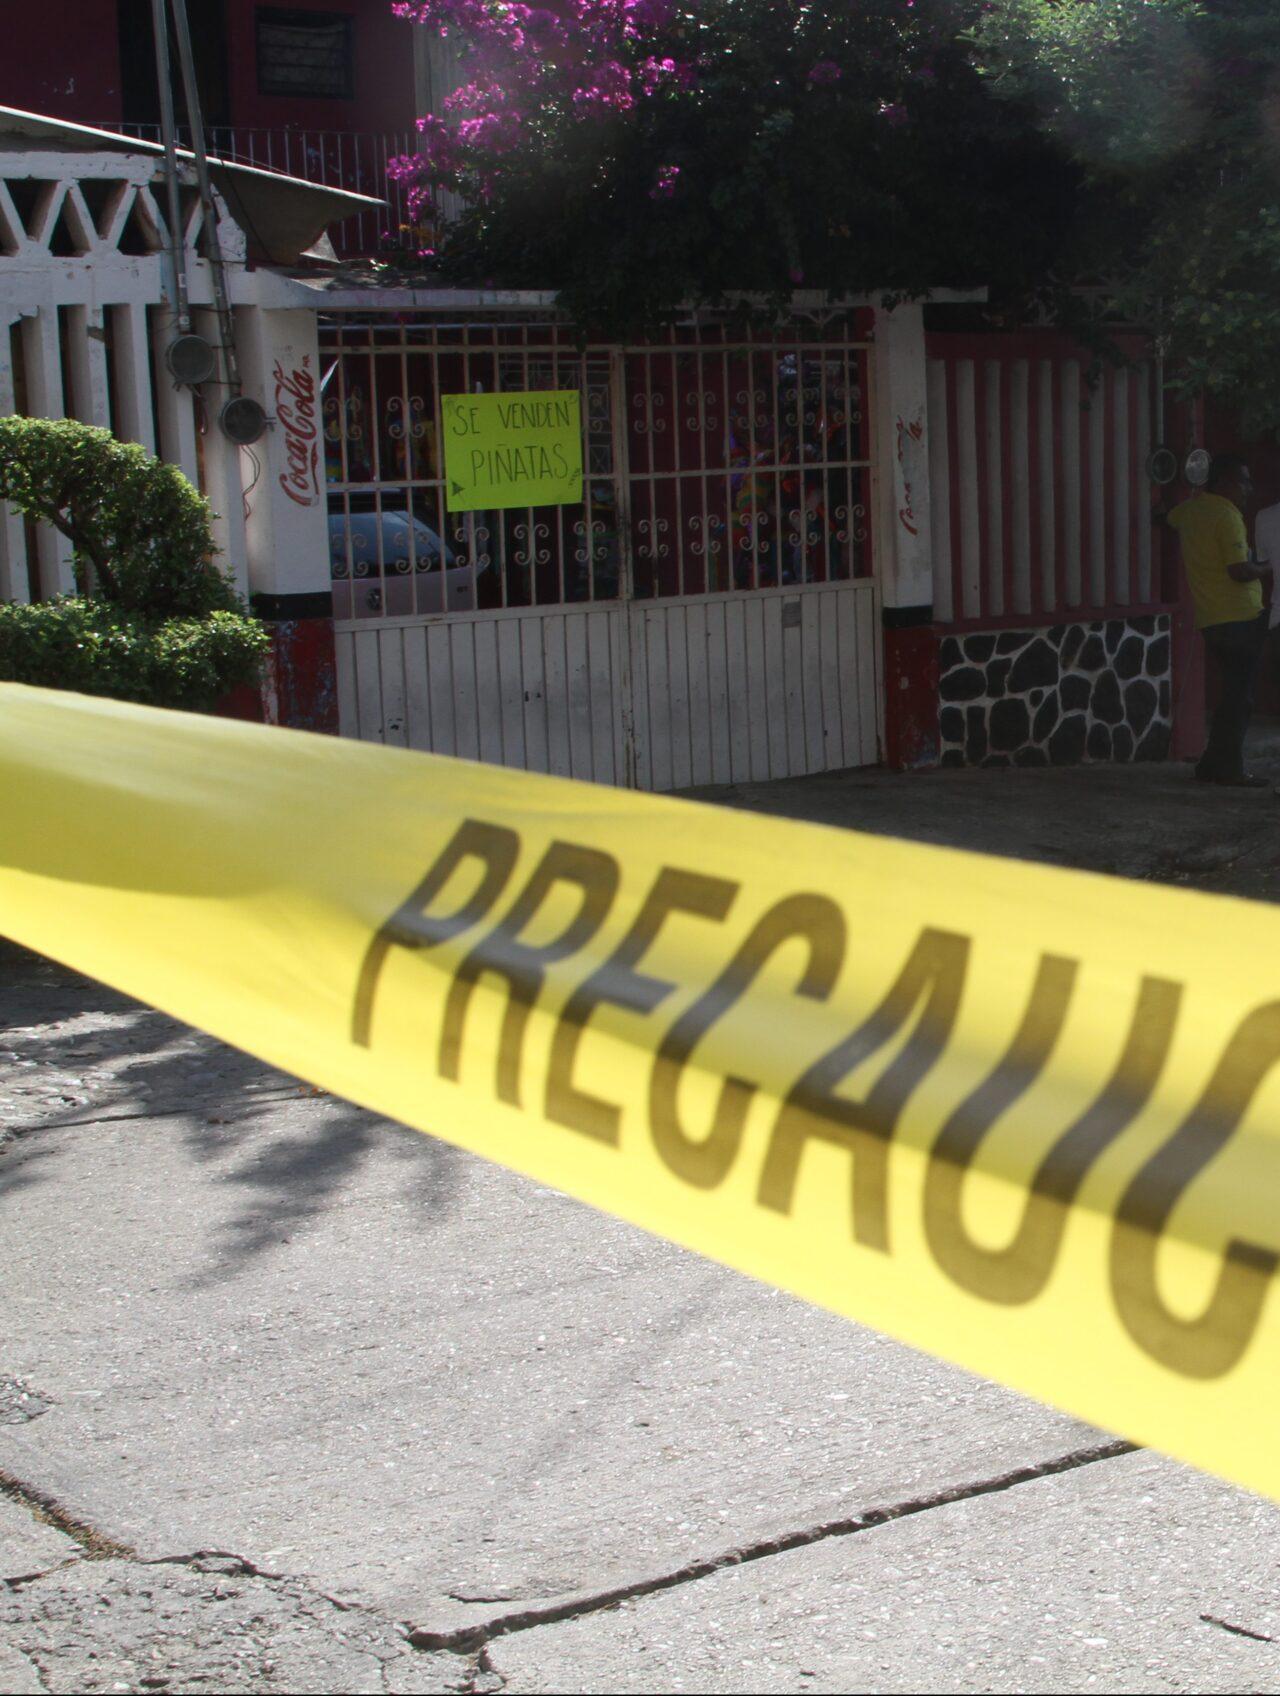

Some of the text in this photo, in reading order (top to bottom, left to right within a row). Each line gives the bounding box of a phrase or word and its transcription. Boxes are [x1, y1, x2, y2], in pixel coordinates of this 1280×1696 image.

[452, 401, 570, 436] SE VENDEN
[471, 443, 568, 486] PIÑATAS
